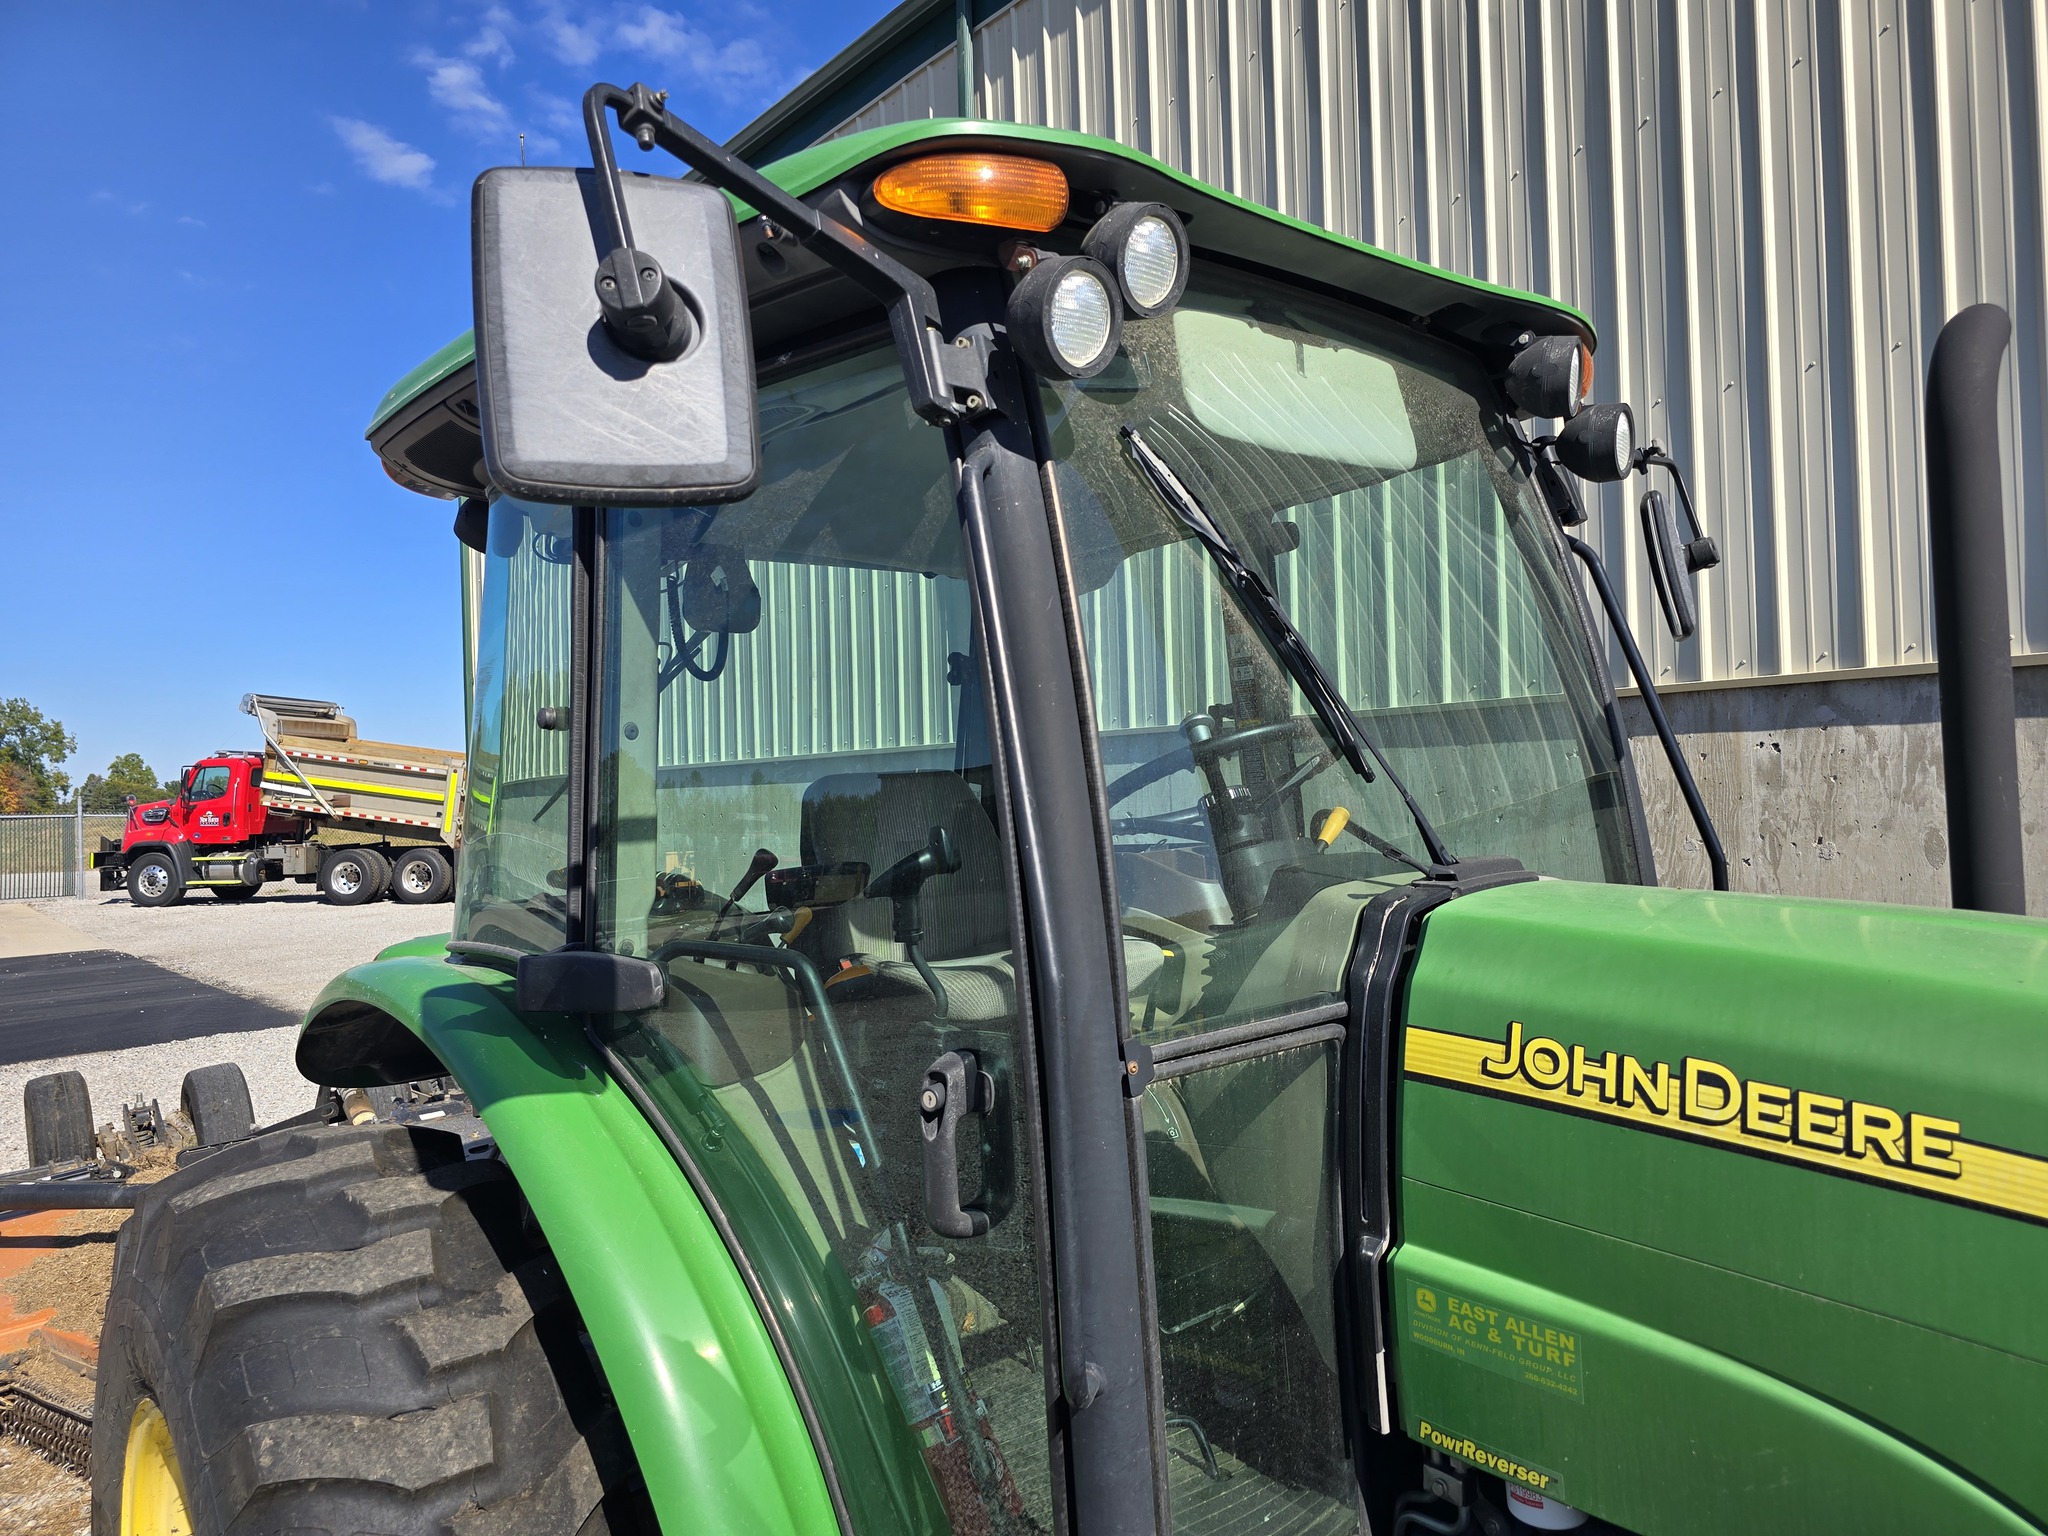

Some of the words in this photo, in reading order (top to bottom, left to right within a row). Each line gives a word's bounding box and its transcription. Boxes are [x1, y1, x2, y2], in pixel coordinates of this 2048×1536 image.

[1481, 1020, 1670, 1115] JOHN
[1679, 1056, 1963, 1179] DEERE
[1413, 1319, 1448, 1337] DIVISION
[1451, 1333, 1462, 1342] OF
[1464, 1338, 1516, 1362] KENN-FELD
[1557, 1370, 1577, 1383] LLC
[1448, 1297, 1498, 1325] EAST
[1505, 1317, 1575, 1351] ALLEN
[1448, 1314, 1477, 1335] AG
[1488, 1328, 1502, 1344] &
[1512, 1334, 1576, 1367] TURF
[1456, 1347, 1465, 1356] IN
[1419, 1420, 1549, 1490] PowrReverser
